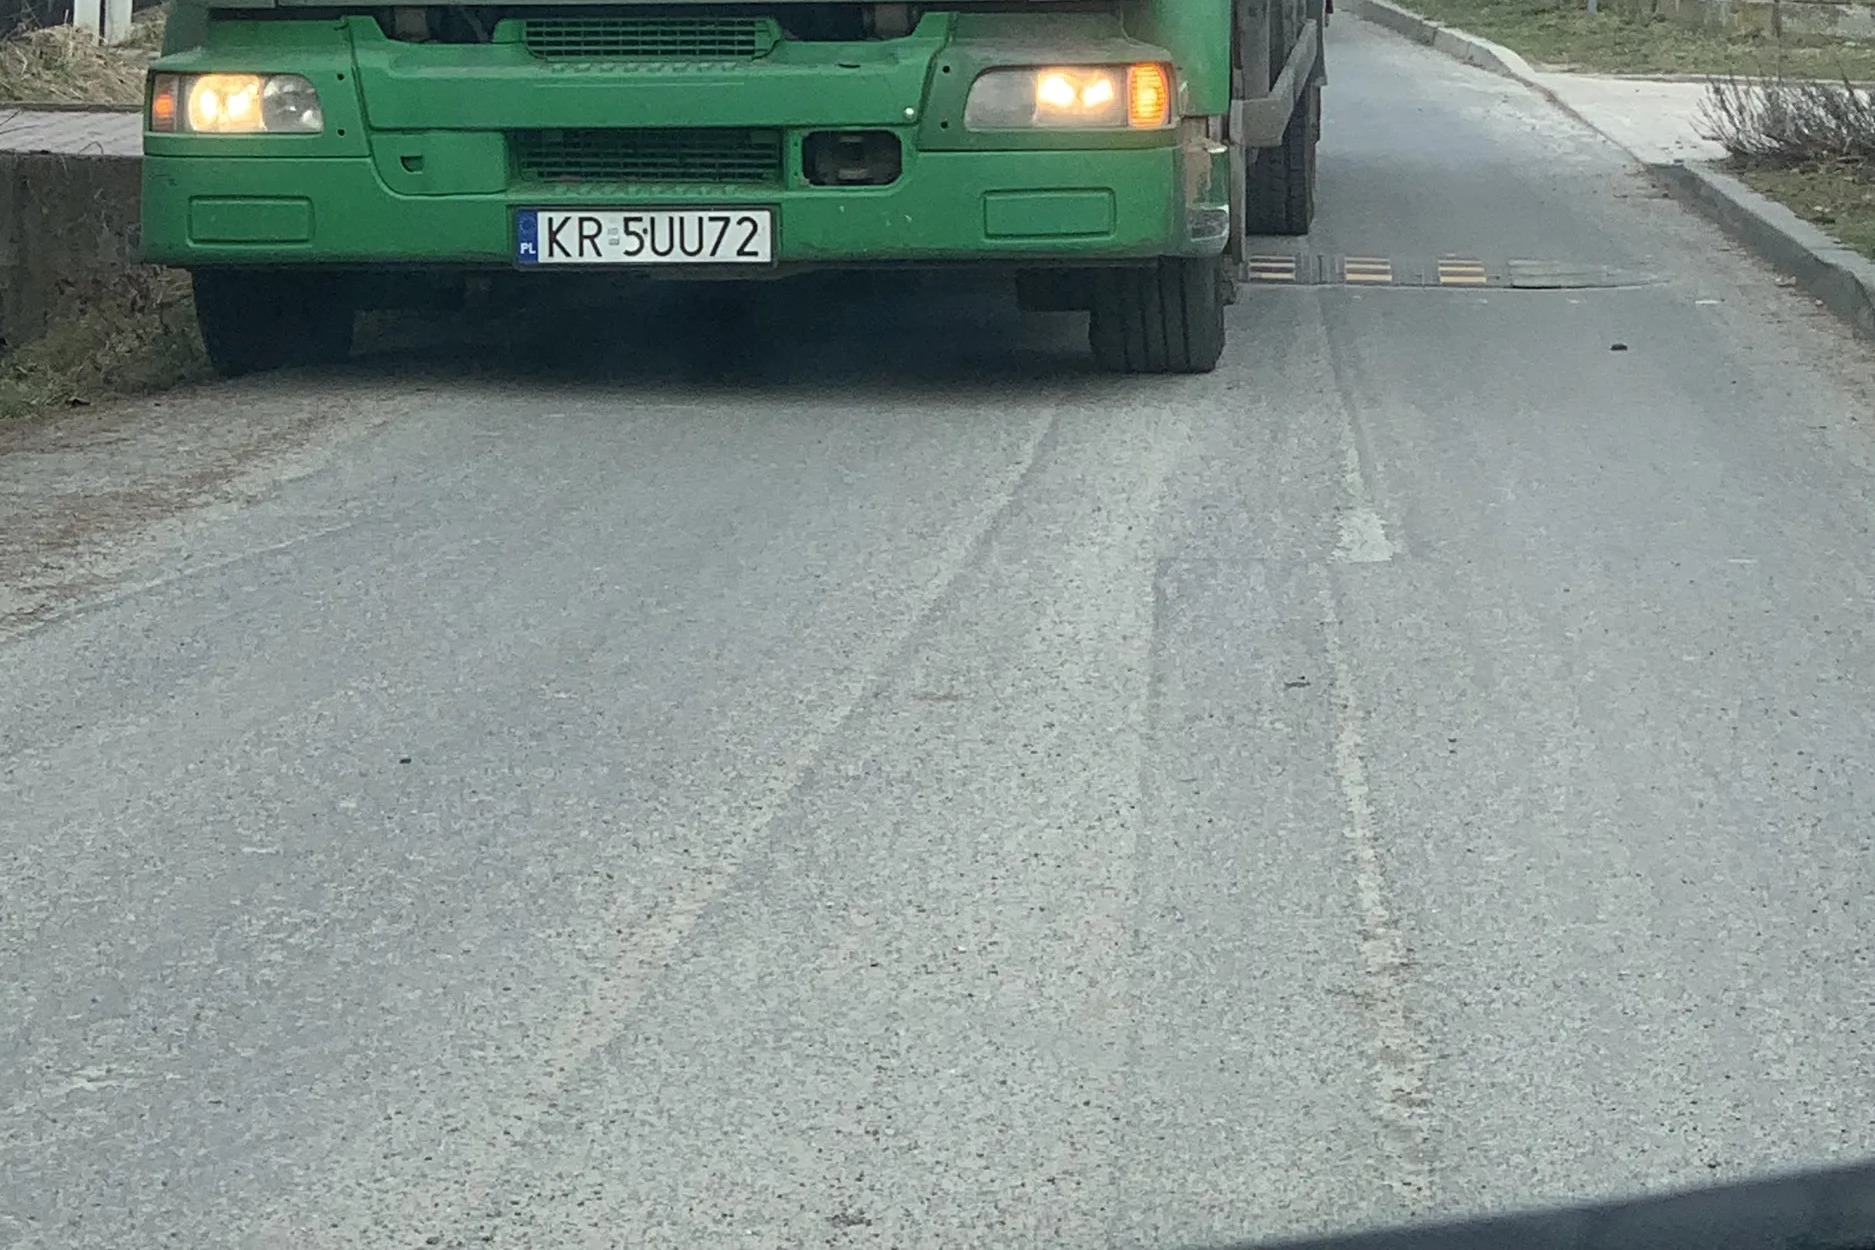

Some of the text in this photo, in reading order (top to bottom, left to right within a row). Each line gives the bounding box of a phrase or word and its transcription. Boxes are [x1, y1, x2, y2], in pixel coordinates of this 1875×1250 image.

[520, 242, 536, 254] PL
[547, 216, 759, 257] KR 5UU72
